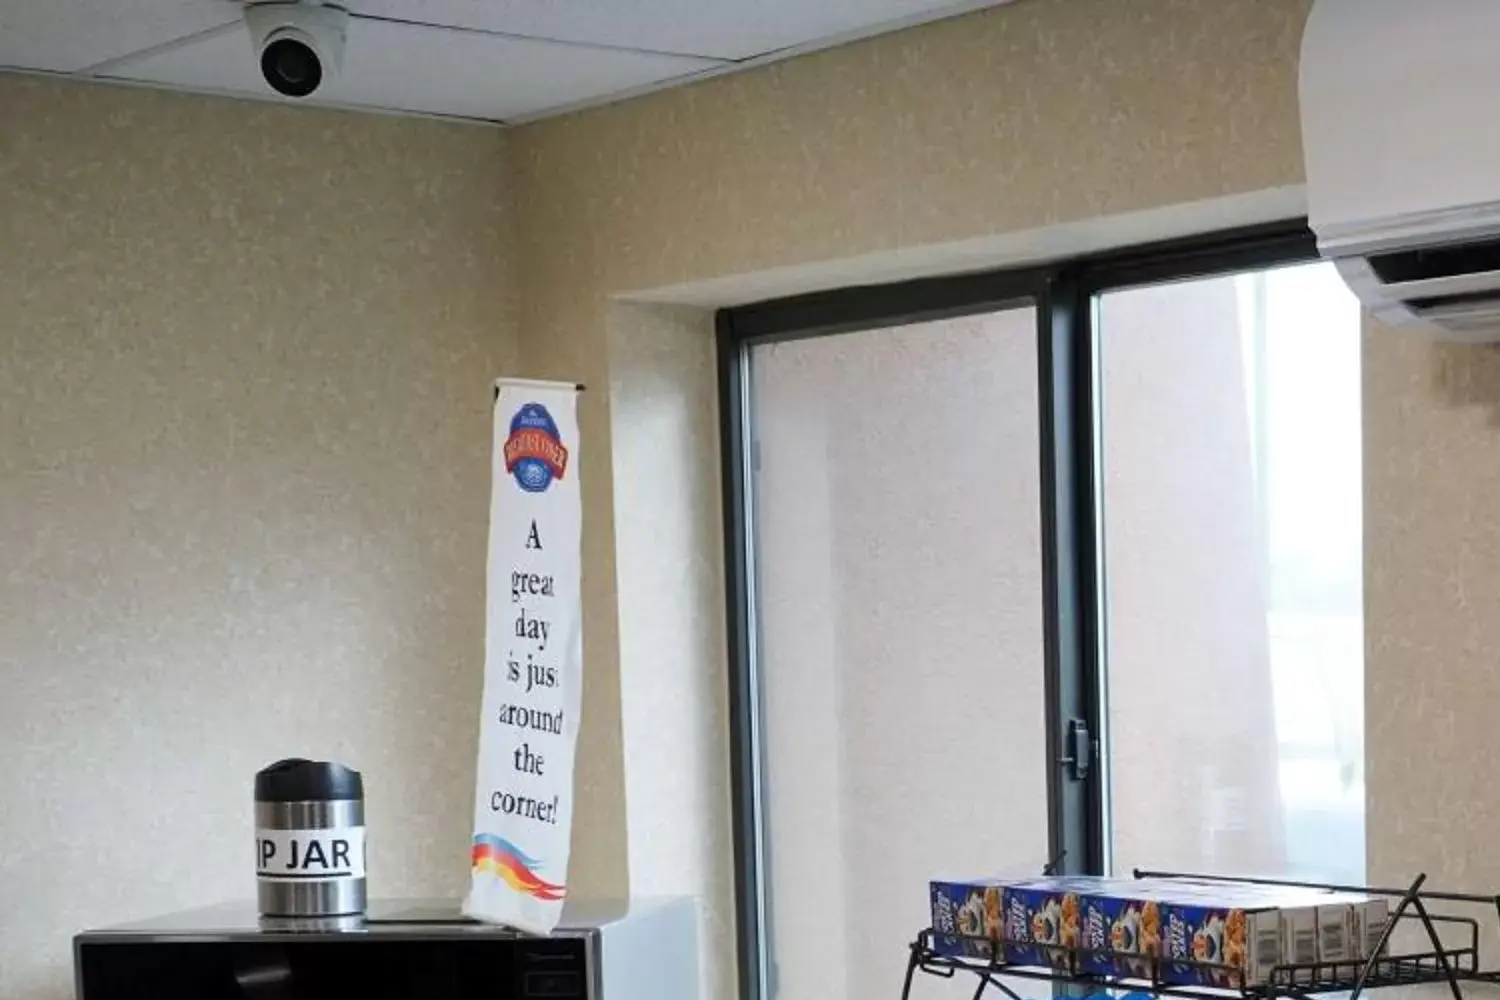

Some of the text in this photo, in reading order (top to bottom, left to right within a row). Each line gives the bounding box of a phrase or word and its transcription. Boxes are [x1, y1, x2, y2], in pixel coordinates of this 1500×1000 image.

[525, 517, 543, 549] A
[515, 607, 551, 651] day
[499, 703, 563, 734] around
[514, 743, 544, 776] the
[491, 791, 559, 824] corner!
[286, 839, 351, 869] JAR
